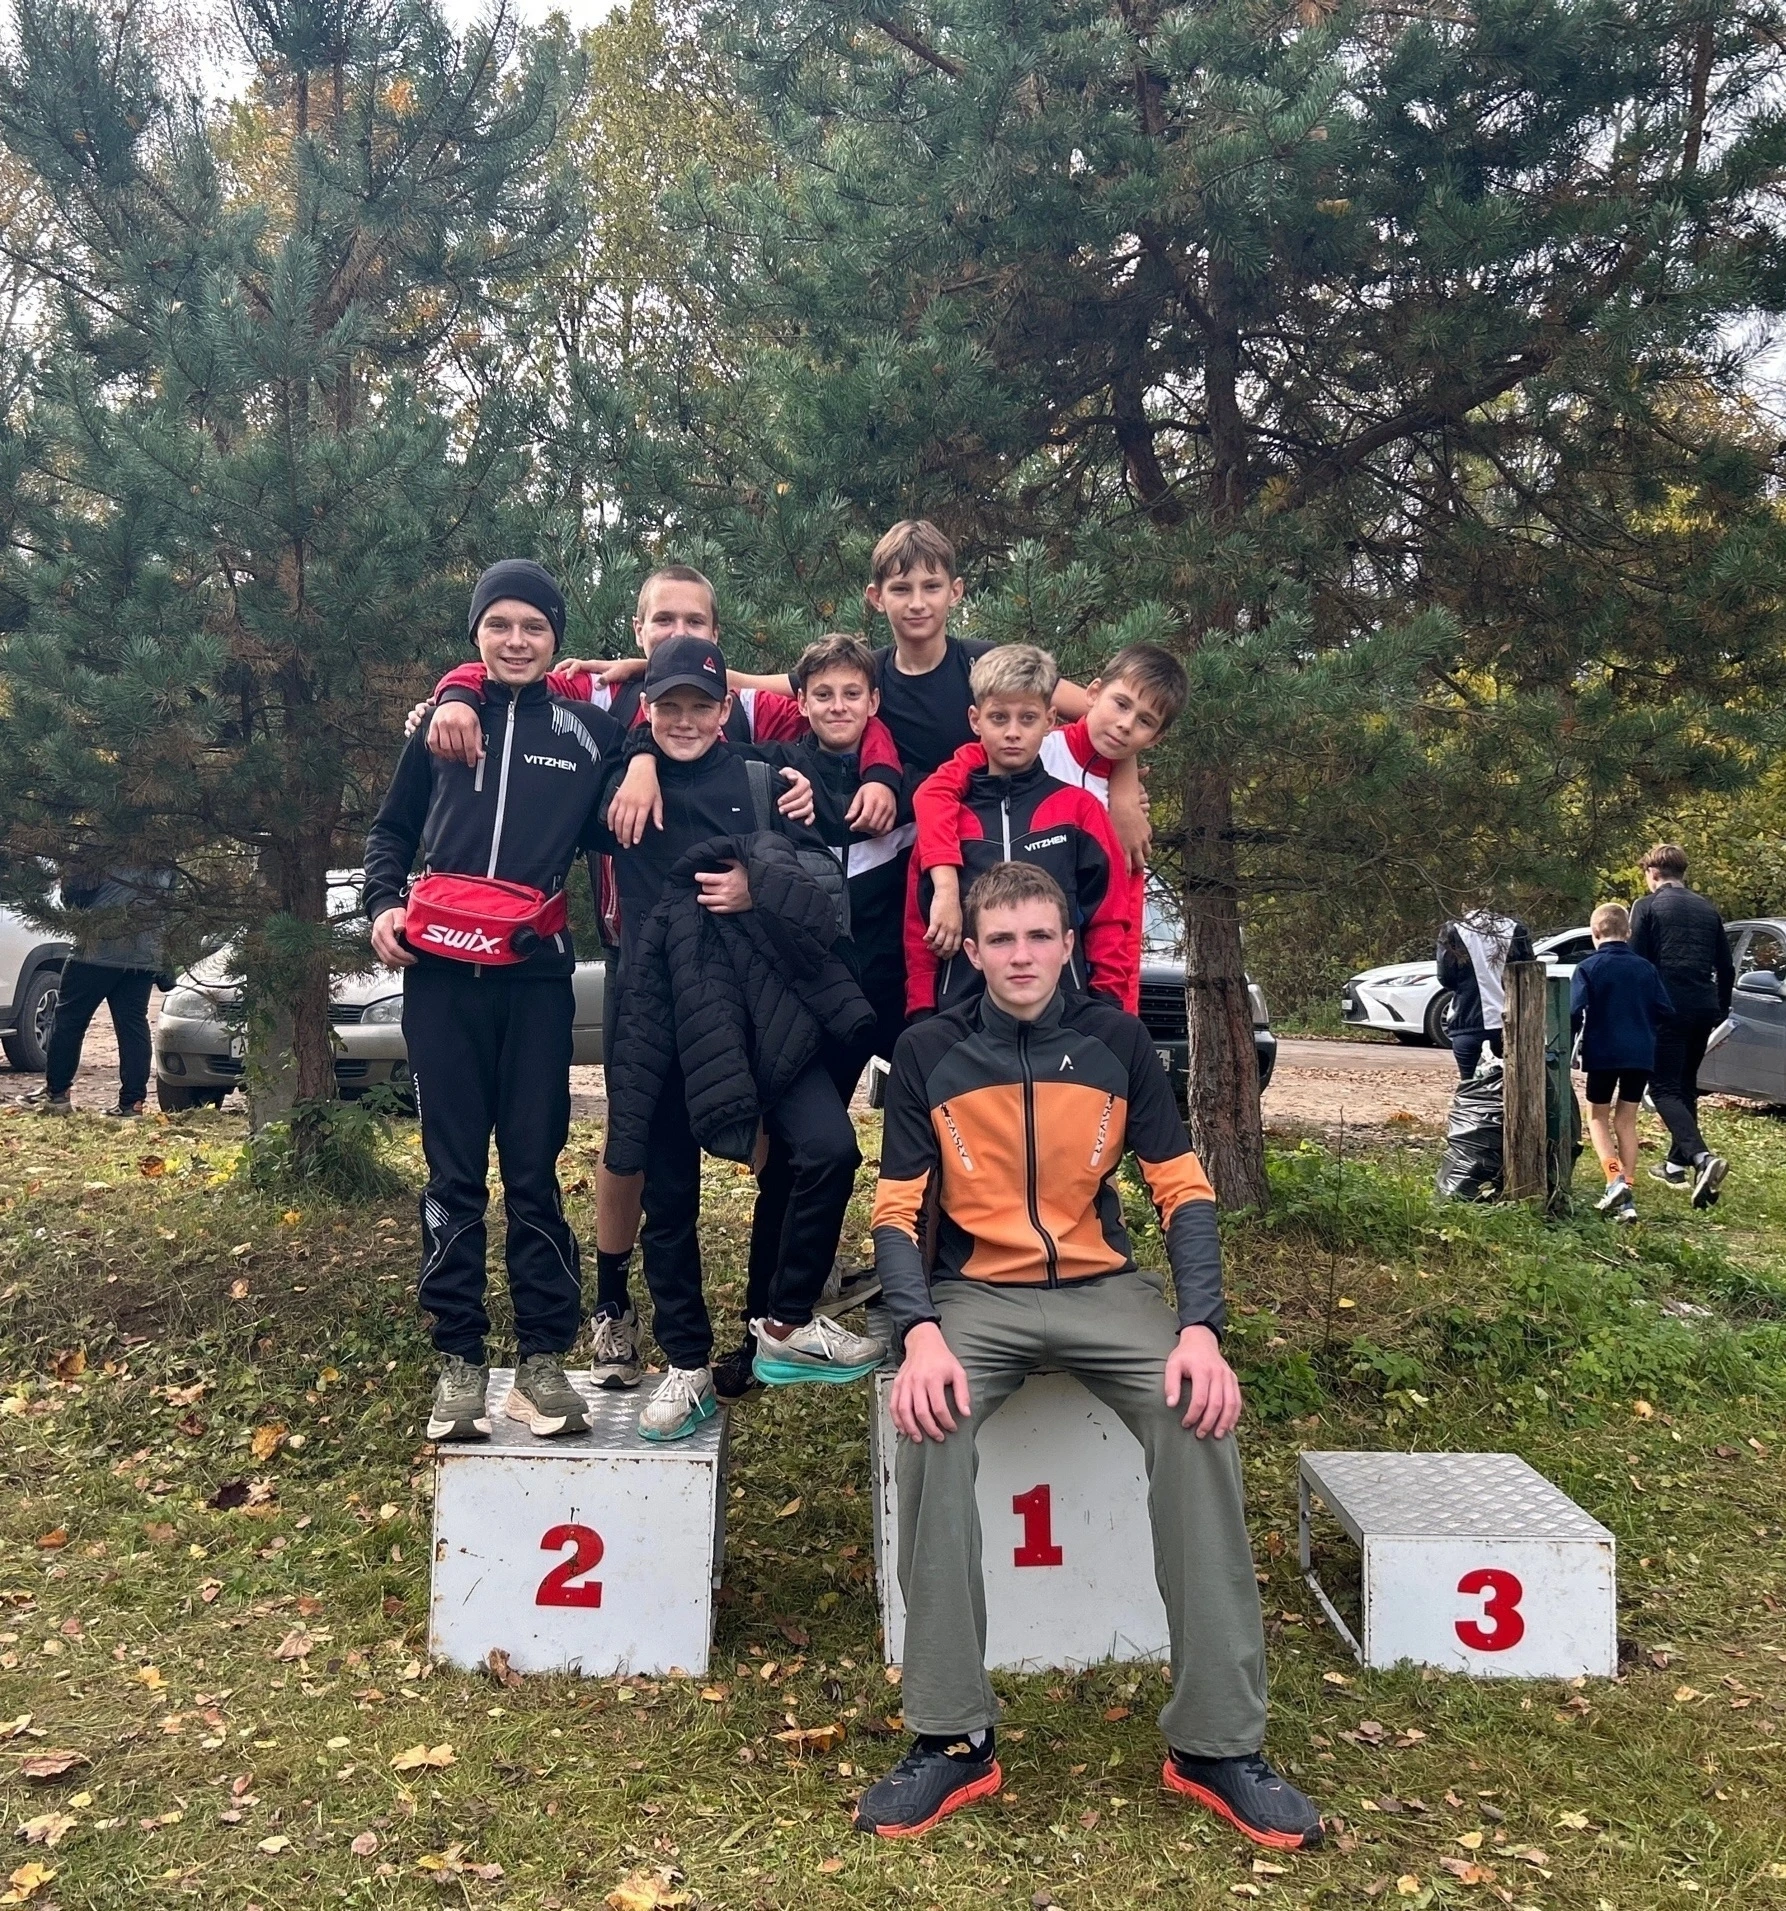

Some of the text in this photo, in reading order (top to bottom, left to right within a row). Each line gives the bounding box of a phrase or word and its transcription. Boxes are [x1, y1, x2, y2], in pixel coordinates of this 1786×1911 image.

[523, 753, 577, 772] VITZHEN
[1023, 834, 1067, 852] VITZHEN
[535, 1524, 604, 1608] 2
[1013, 1484, 1063, 1567] 1
[1455, 1568, 1525, 1652] 3
